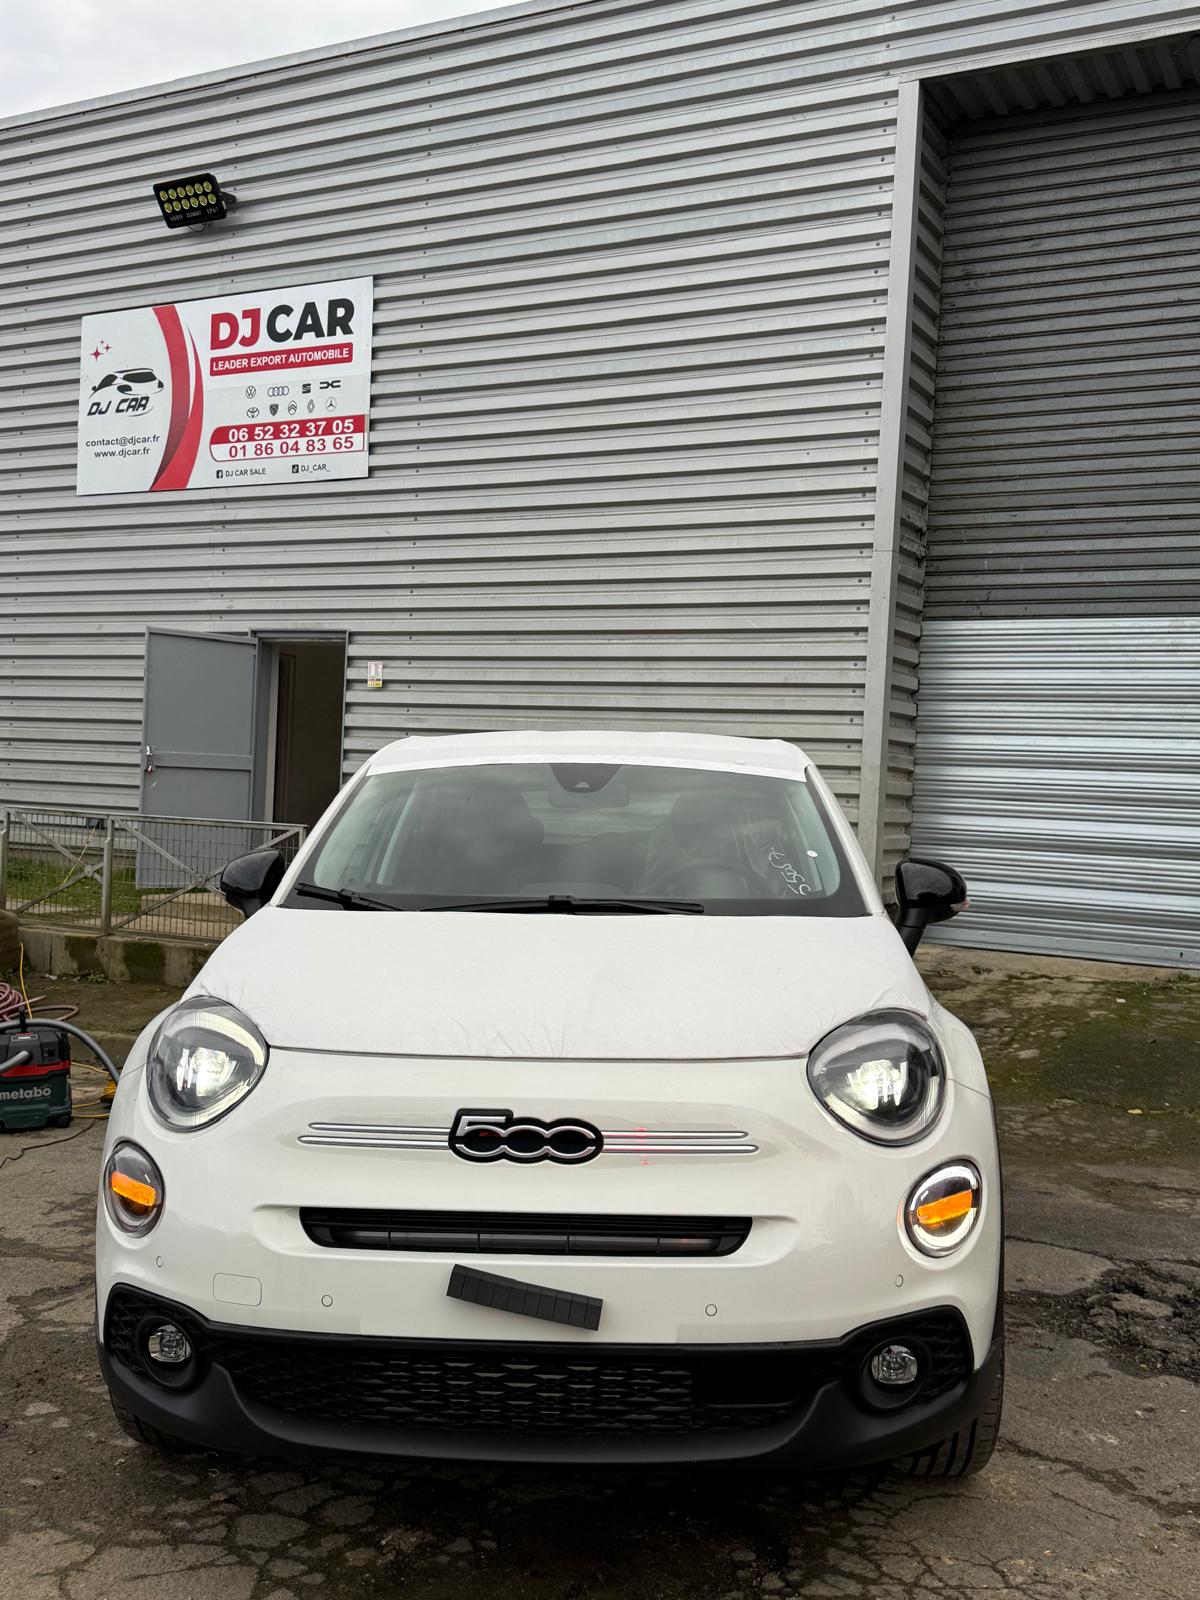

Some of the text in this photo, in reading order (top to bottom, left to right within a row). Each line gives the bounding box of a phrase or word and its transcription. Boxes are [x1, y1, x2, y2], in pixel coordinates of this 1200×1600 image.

[210, 298, 355, 350] DJ CAR
[212, 347, 350, 371] LEADER EXPORT AUTOMOBILE
[86, 396, 150, 416] DJ CAR
[85, 434, 160, 447] contact@djcar.fr
[228, 419, 354, 442] 06 52 32 37 05
[94, 446, 150, 458] www.djcar.fr
[228, 435, 354, 458] 01 86 04 83 65
[234, 469, 249, 477] CAR
[249, 467, 267, 476] SALE
[0, 1087, 51, 1099] metabo
[455, 1115, 597, 1159] 500
